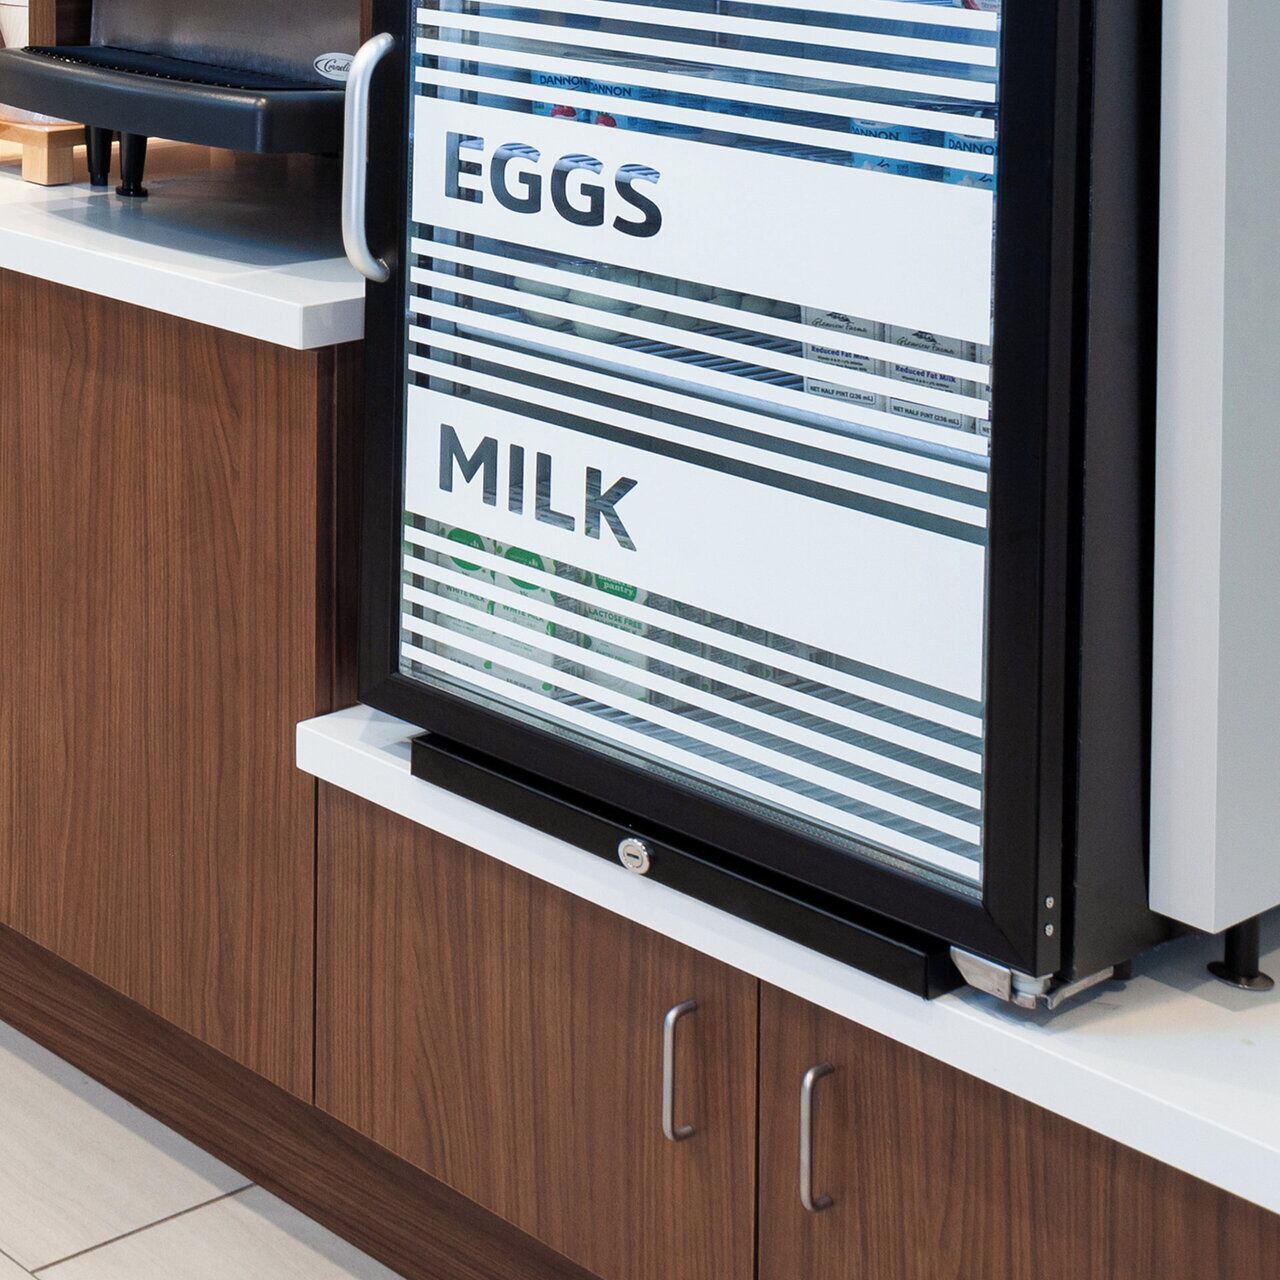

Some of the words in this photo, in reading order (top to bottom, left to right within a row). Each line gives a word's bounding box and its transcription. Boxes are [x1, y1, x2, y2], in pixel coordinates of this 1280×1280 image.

[444, 130, 662, 238] EGGS
[439, 423, 638, 552] MILK
[603, 582, 634, 596] pantry
